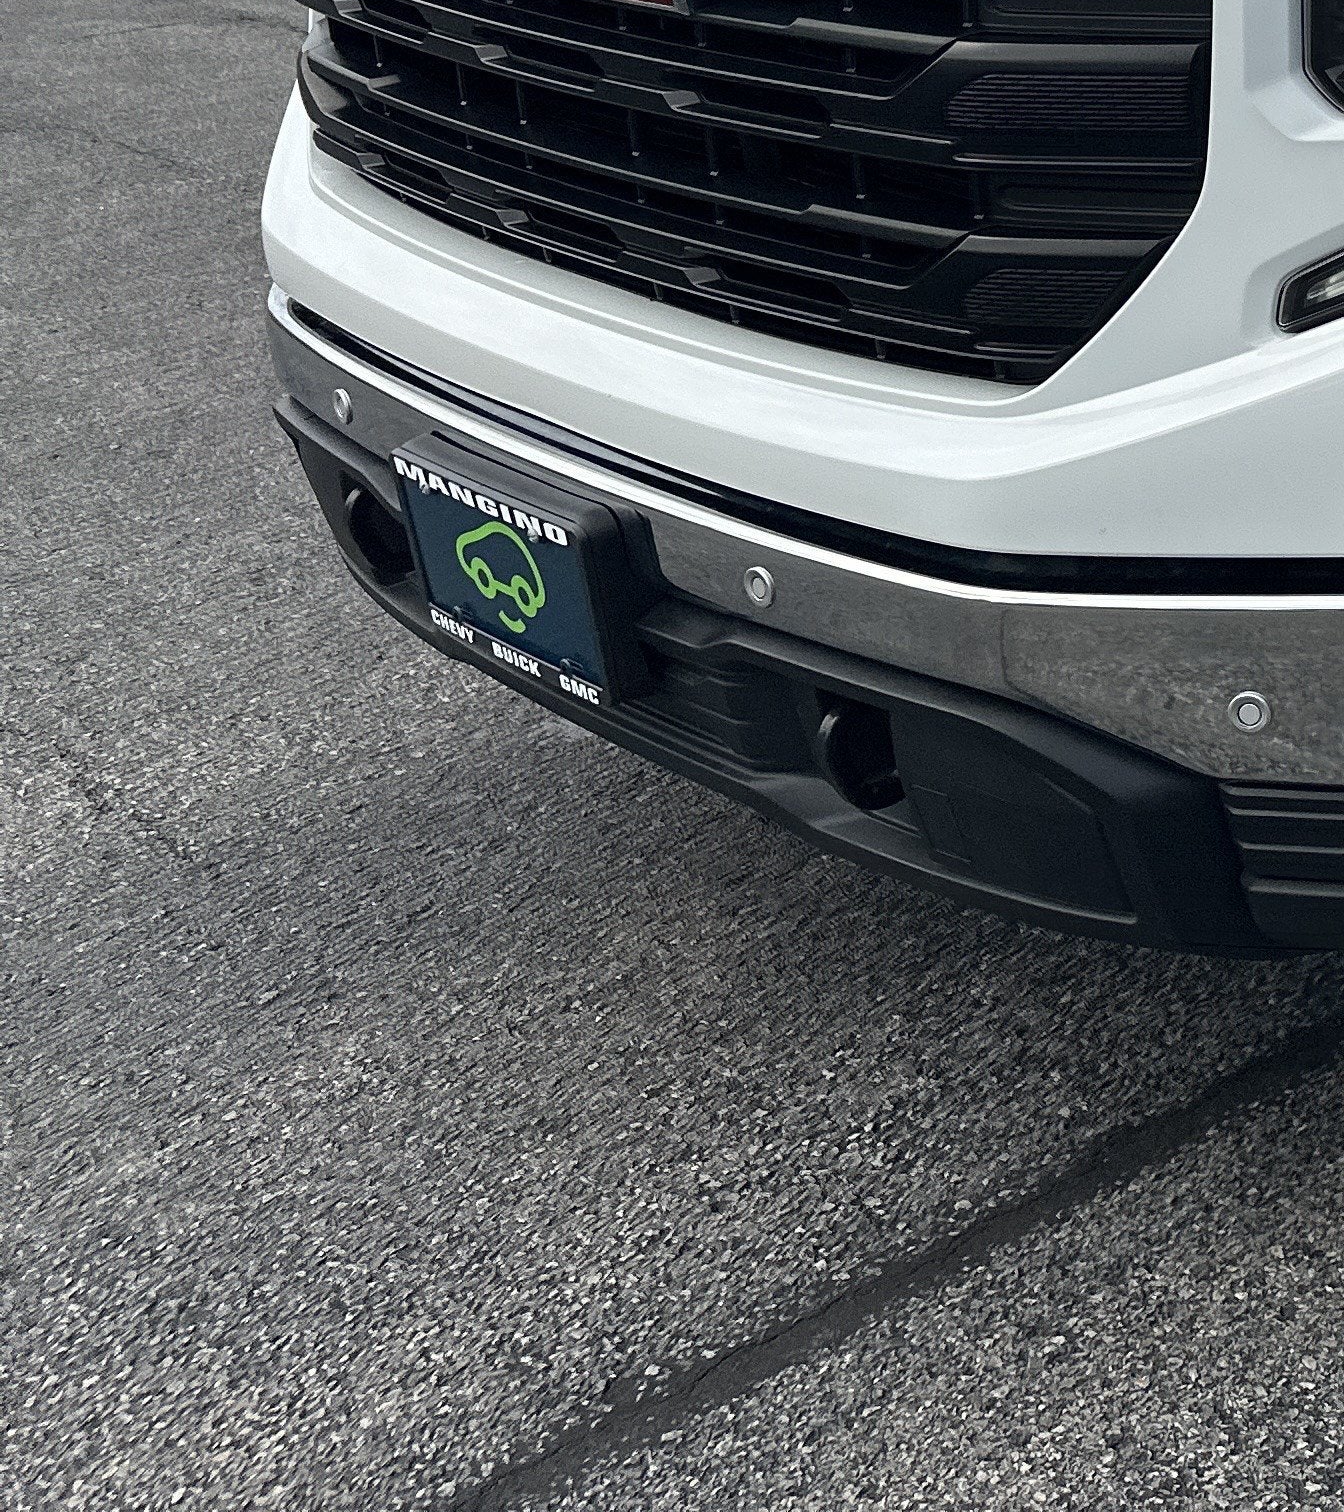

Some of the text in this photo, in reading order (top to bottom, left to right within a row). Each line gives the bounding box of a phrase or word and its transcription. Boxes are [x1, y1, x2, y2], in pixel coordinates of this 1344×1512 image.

[393, 455, 569, 547] MANGINO
[429, 608, 601, 706] CHEVY BUICK GMC
